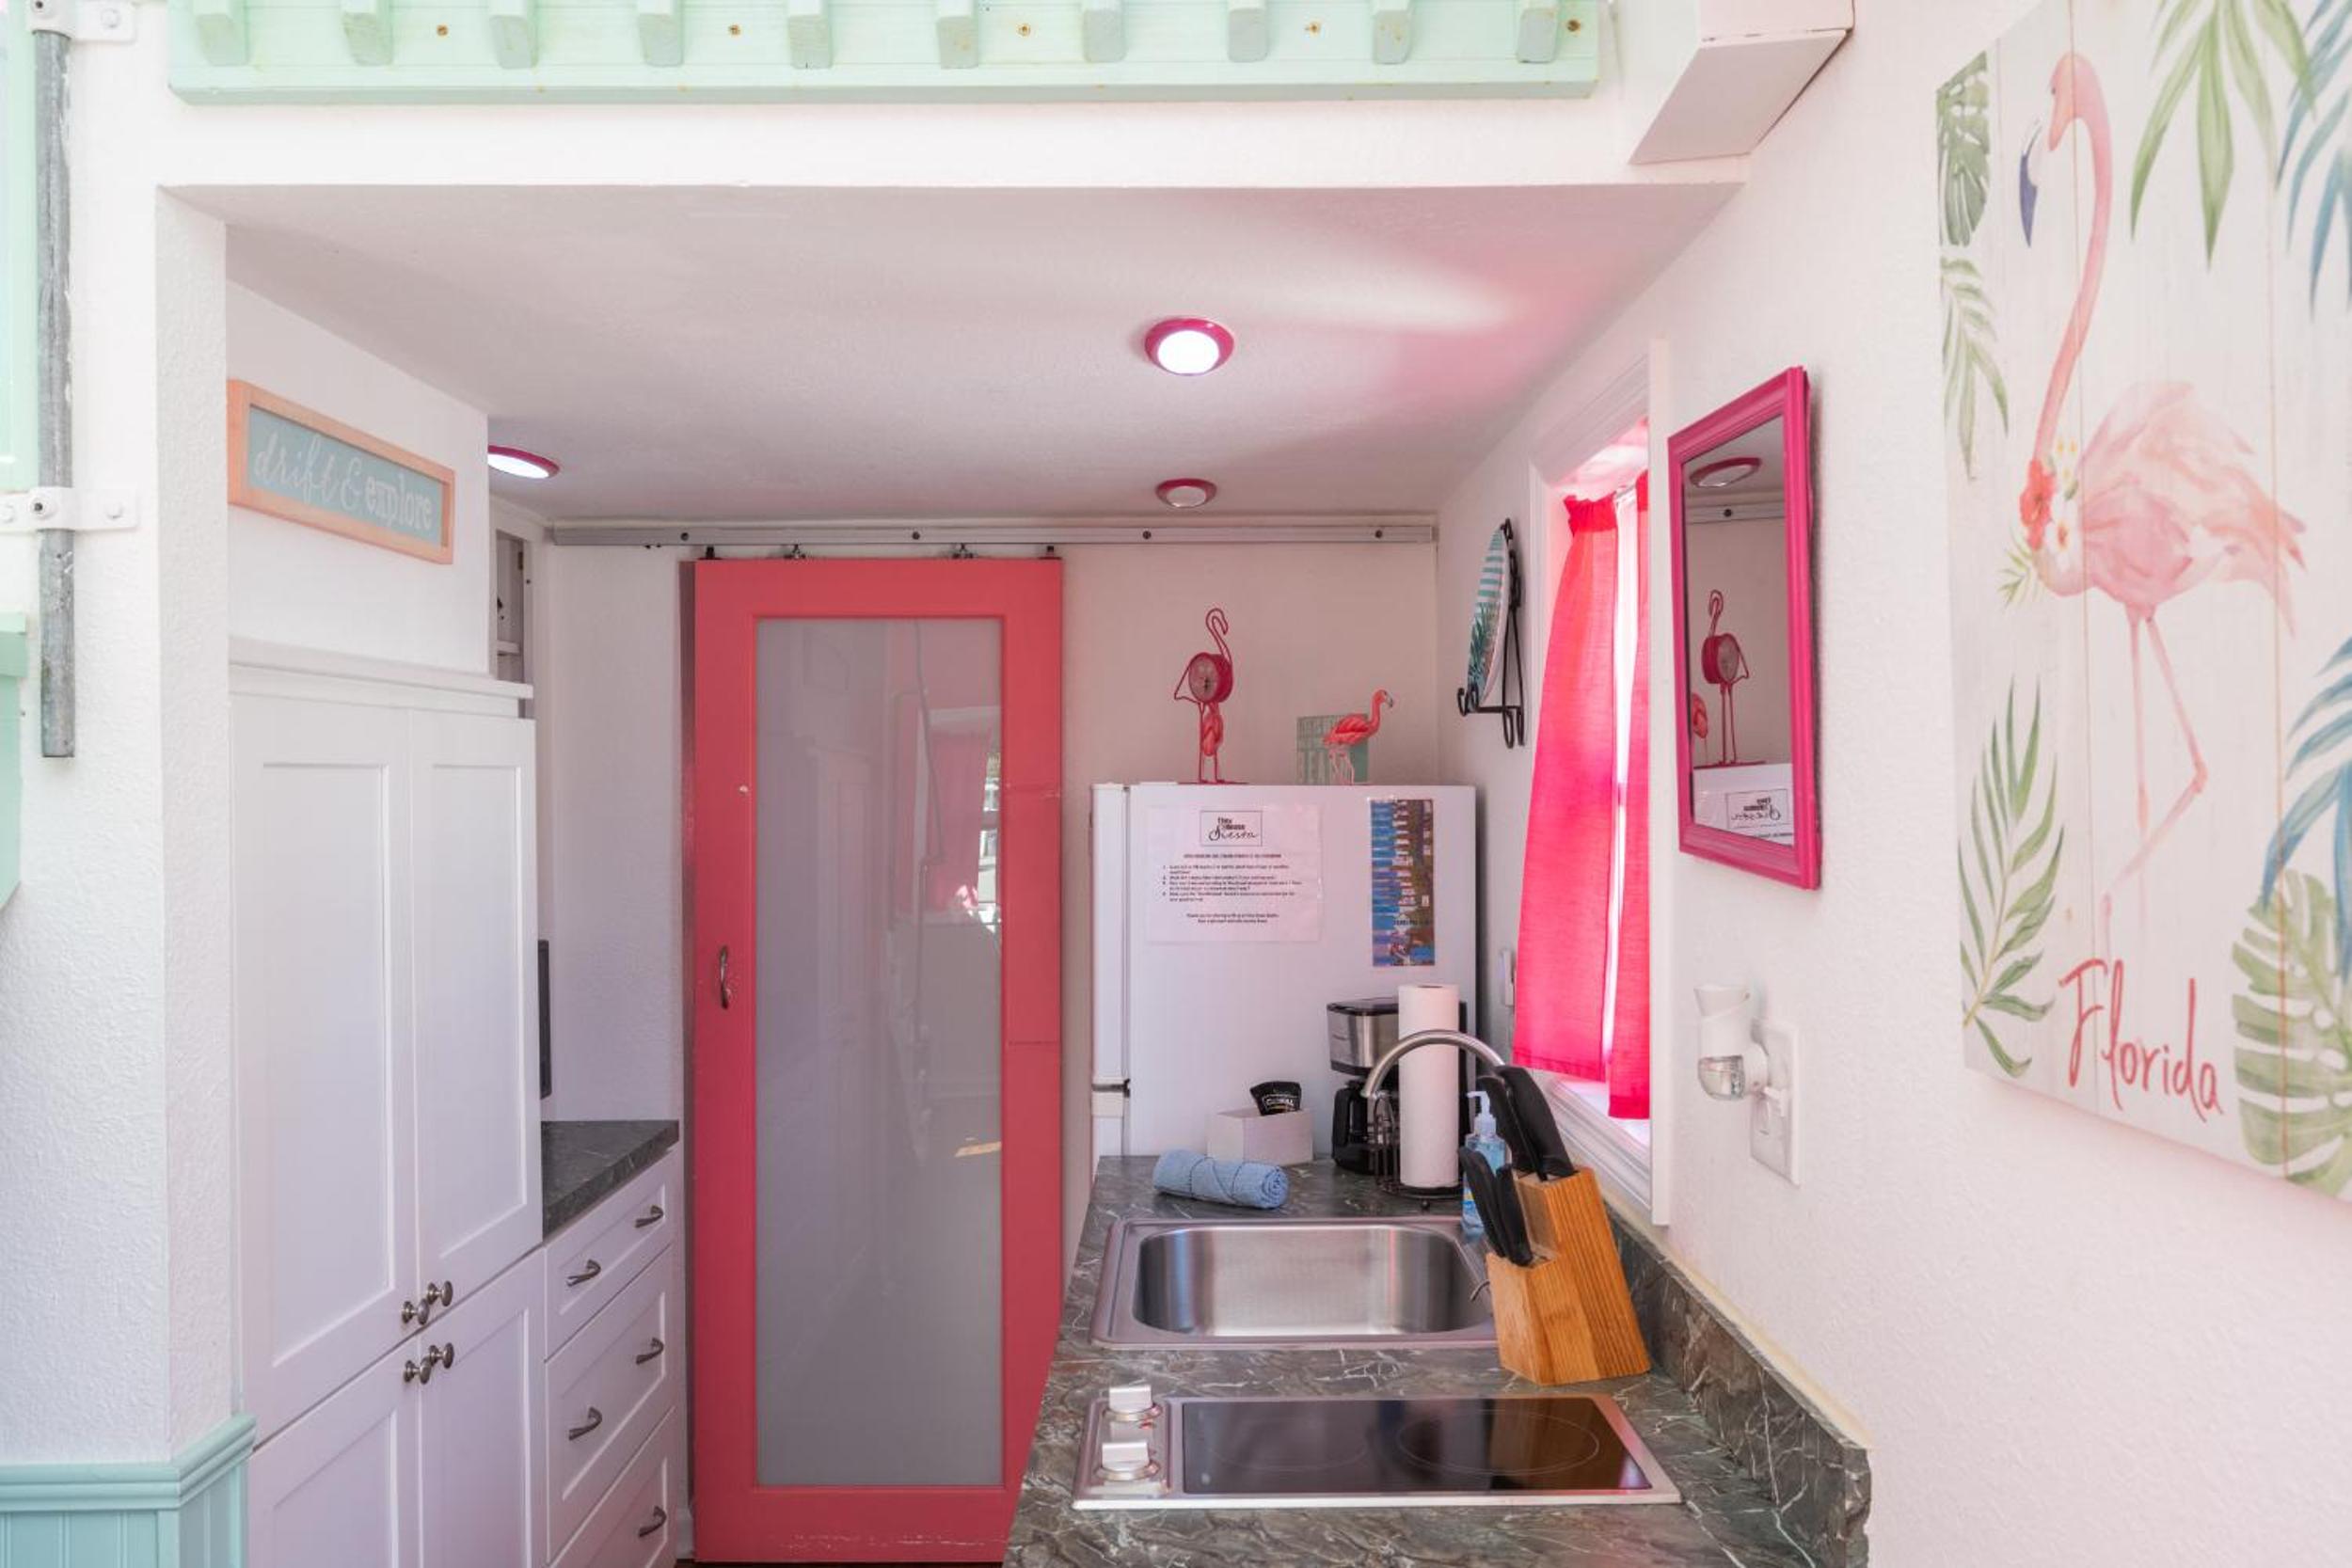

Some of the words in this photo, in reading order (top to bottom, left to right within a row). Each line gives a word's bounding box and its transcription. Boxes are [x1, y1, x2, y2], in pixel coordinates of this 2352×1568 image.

[253, 431, 339, 505] drift
[364, 472, 433, 531] explore
[2058, 958, 2225, 1124] Florida
